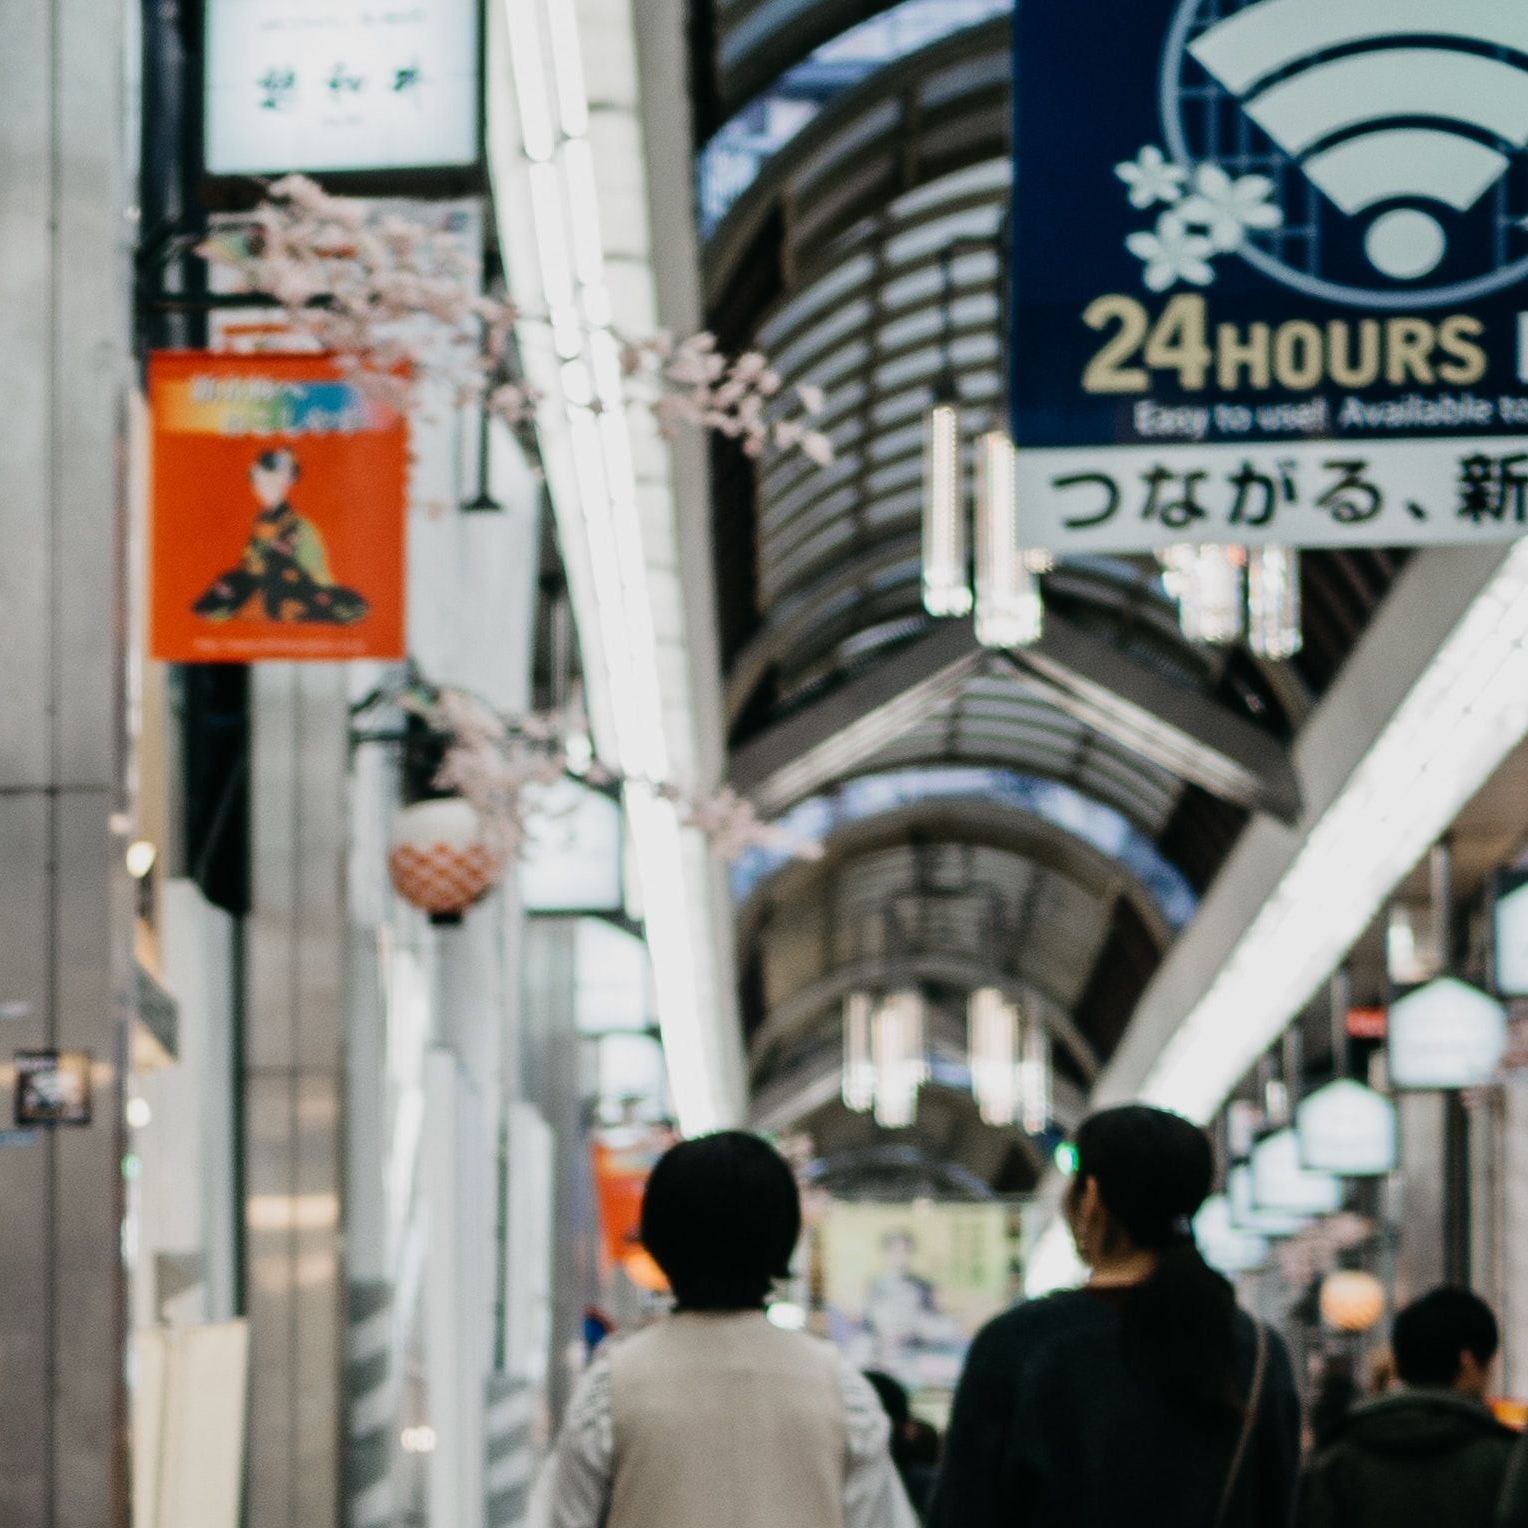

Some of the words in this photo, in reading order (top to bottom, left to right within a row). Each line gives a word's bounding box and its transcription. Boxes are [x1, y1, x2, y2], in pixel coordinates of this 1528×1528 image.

[1080, 292, 1487, 394] 24HOURS
[1133, 399, 1210, 439] Easy
[1213, 399, 1252, 433] to
[1338, 392, 1493, 430] Available
